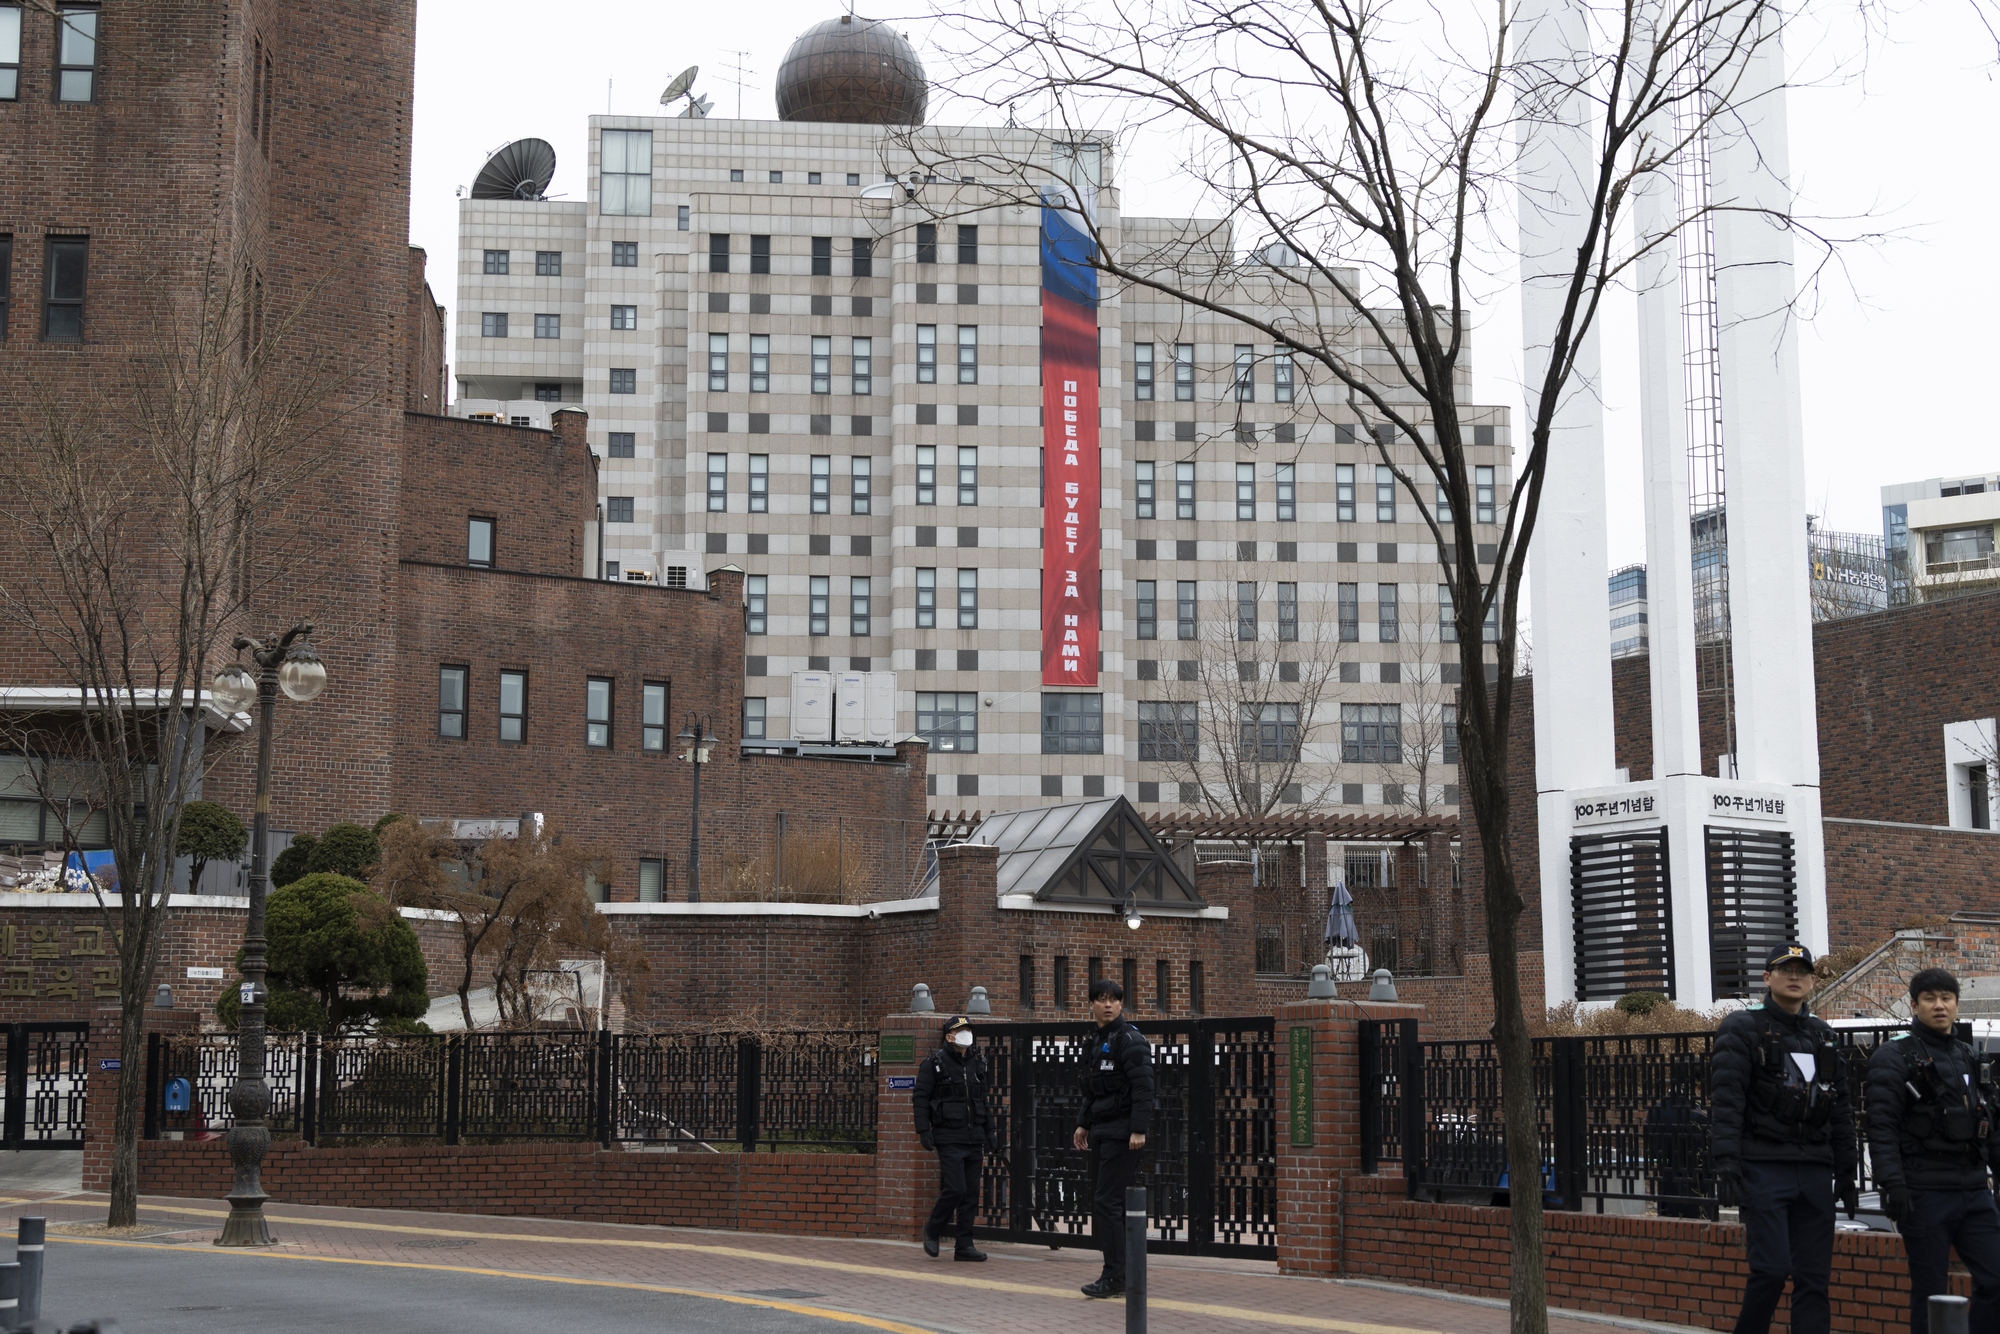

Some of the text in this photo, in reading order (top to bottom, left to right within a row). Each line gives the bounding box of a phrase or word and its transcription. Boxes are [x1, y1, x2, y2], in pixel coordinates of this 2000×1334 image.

[1061, 379, 1081, 672] ПОБЕДА БУДЕТ ЗА НАМИ
[0, 925, 123, 960] 일교
[243, 992, 249, 1001] 2
